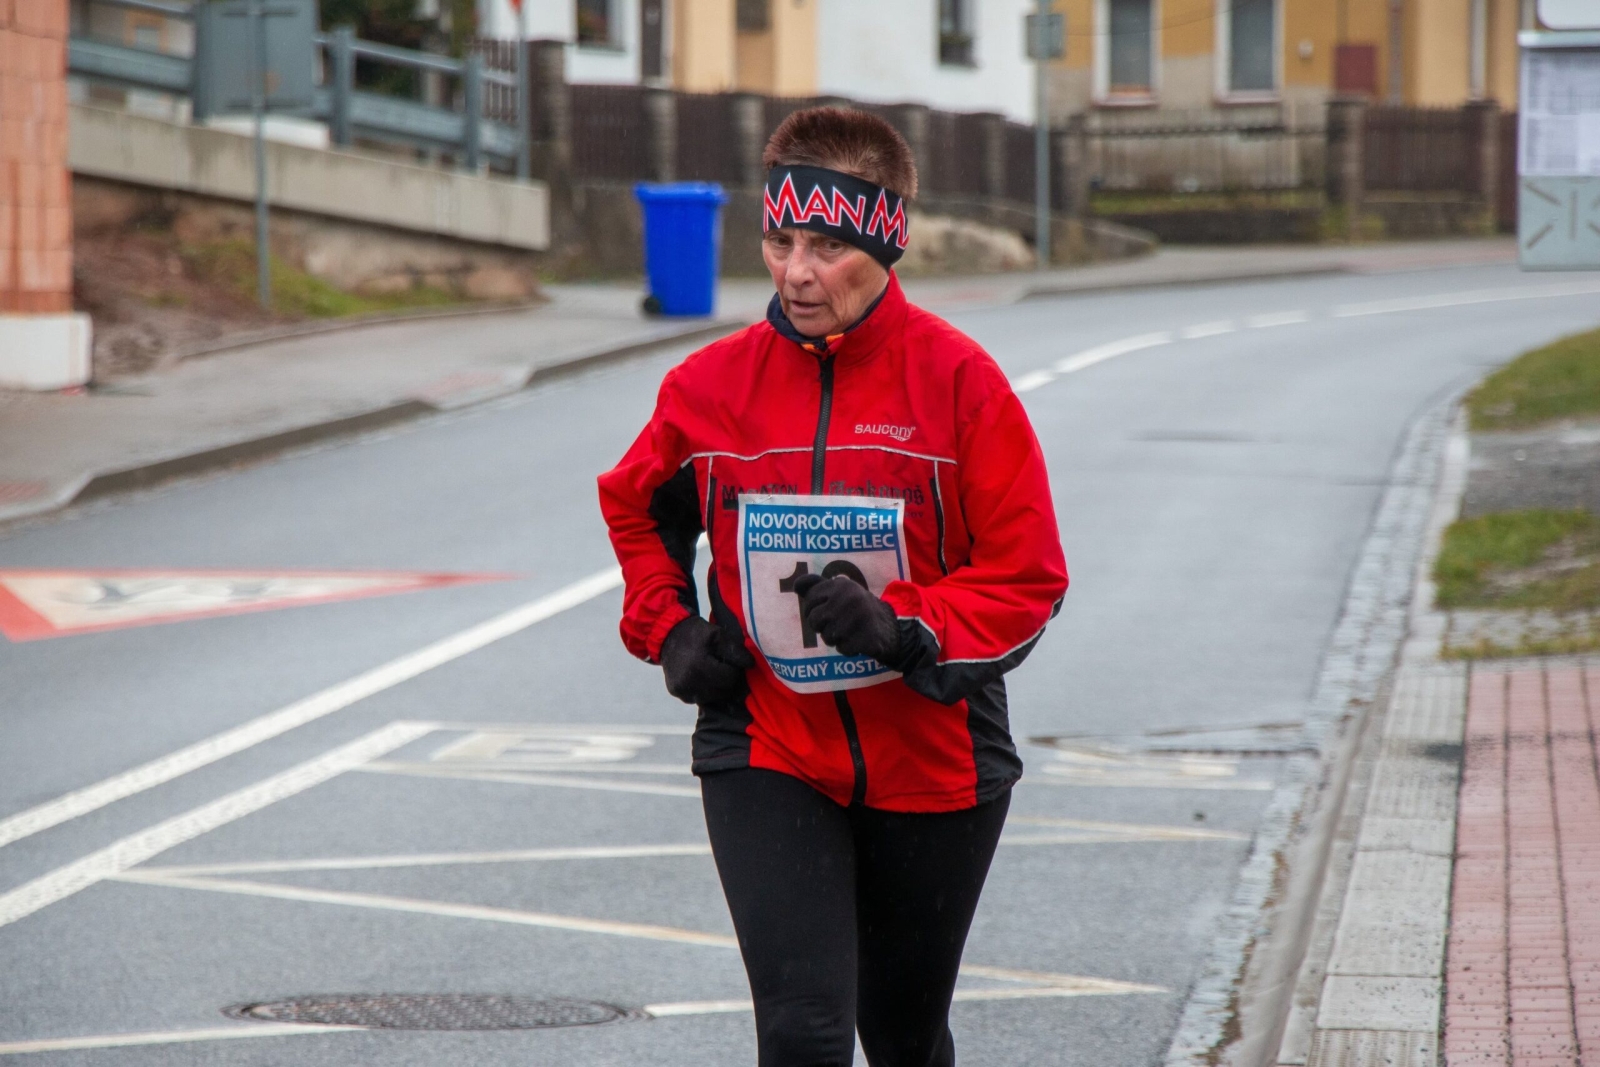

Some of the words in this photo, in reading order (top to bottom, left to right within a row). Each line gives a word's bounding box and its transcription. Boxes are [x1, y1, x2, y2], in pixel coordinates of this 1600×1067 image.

[749, 512, 851, 531] NOVOROČNÍ
[856, 512, 892, 530] BĚH
[748, 531, 801, 549] HORNÍ
[806, 533, 895, 550] KOSTELEC
[833, 659, 887, 675] KOSTE
